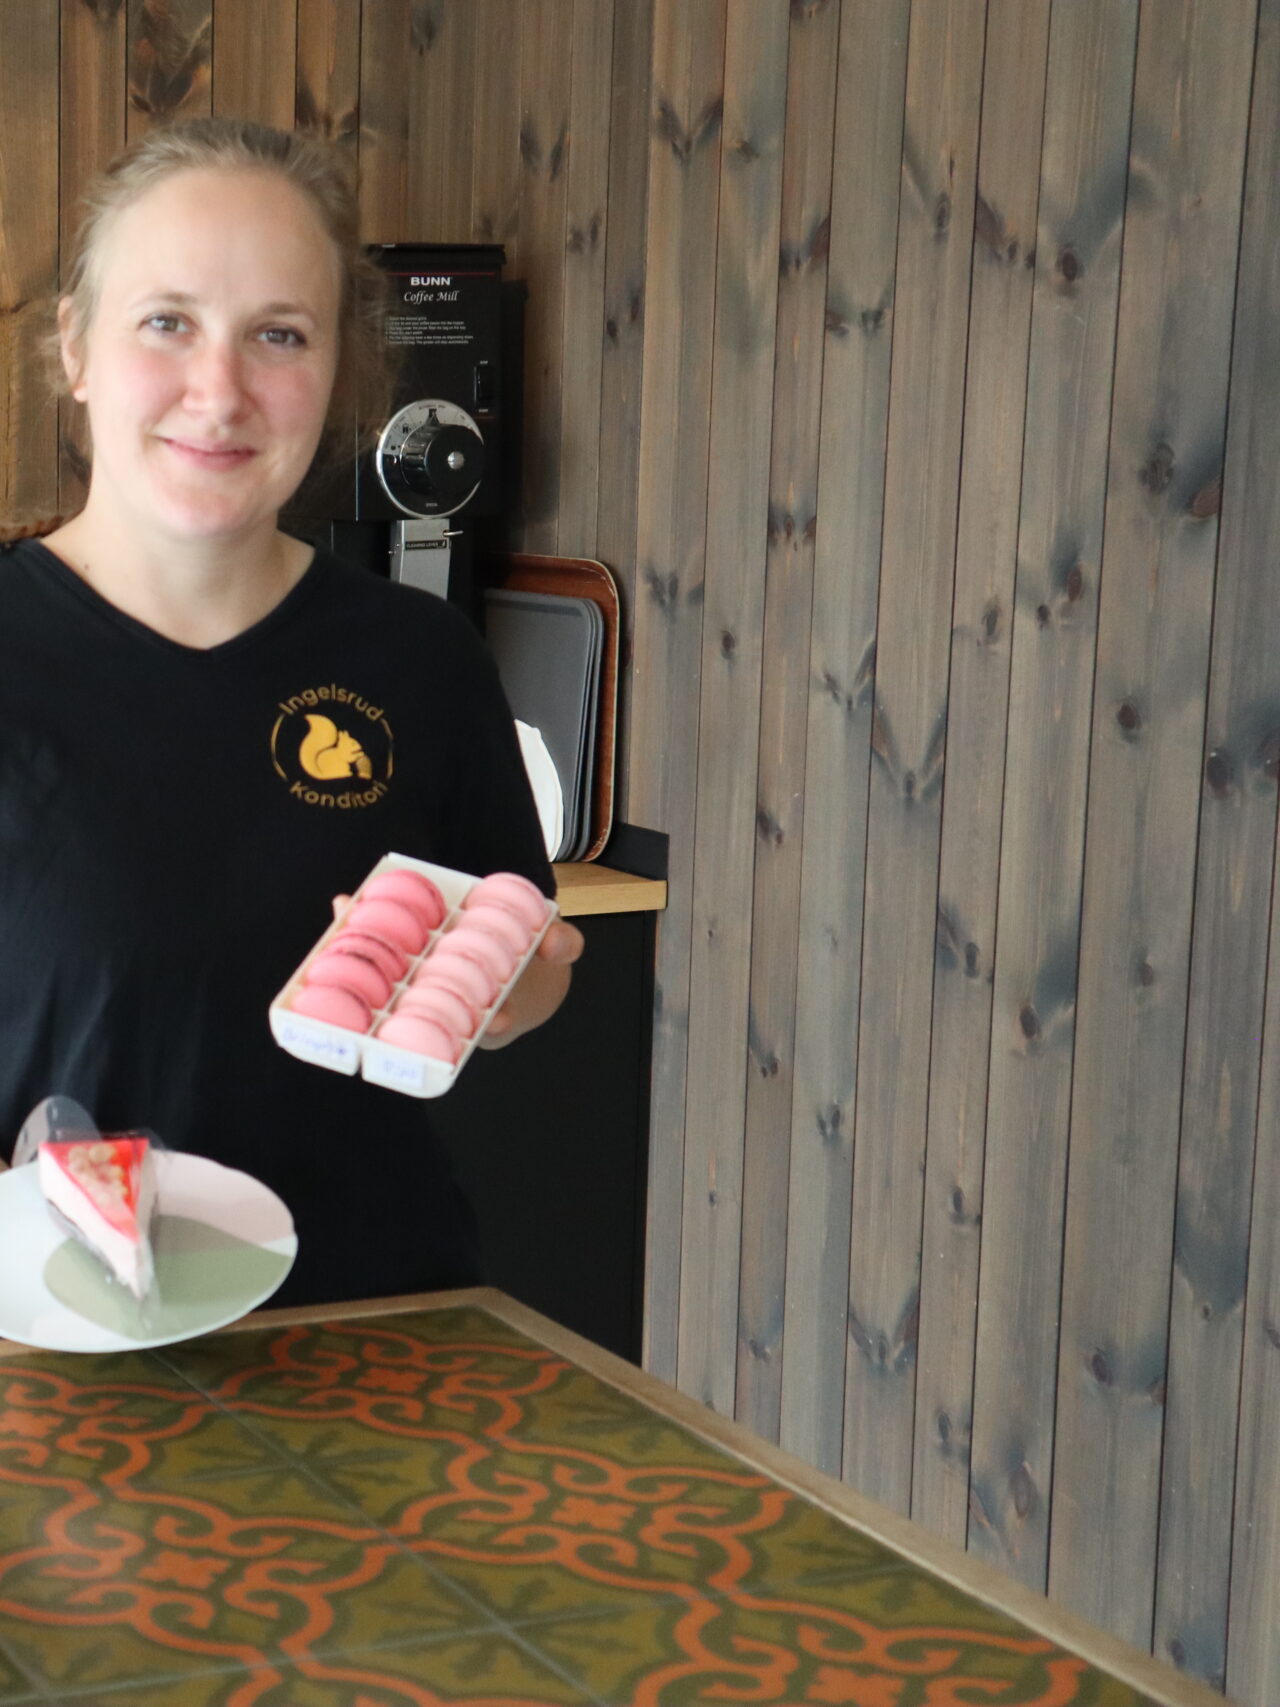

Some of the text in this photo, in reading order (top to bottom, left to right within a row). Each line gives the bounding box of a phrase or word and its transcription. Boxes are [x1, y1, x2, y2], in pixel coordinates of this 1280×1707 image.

[410, 276, 451, 286] BUNN
[404, 290, 460, 305] Coffee Mill
[278, 683, 384, 721] Ingelsrud
[289, 780, 388, 809] Konditori
